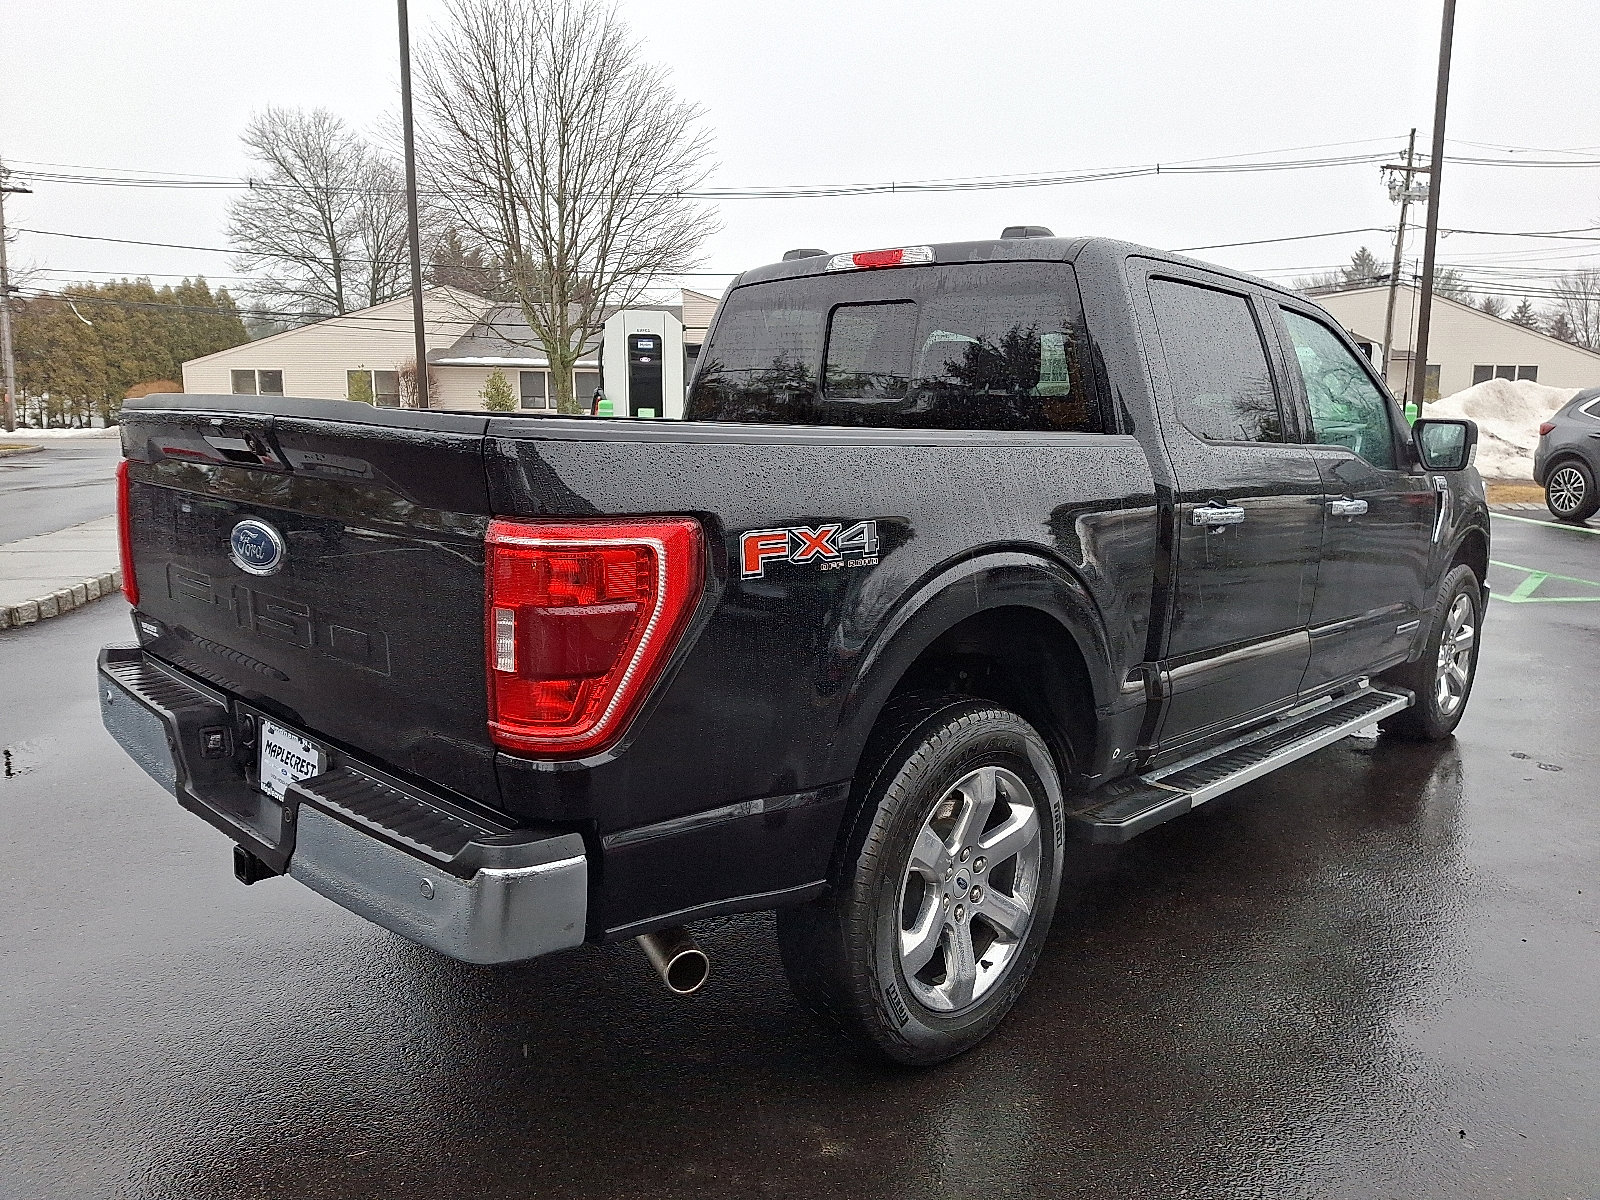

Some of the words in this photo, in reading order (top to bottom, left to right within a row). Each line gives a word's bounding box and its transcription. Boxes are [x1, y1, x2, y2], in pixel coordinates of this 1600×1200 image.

[238, 529, 265, 560] Ford
[739, 520, 880, 580] FX4
[820, 562, 845, 571] OFF
[847, 557, 879, 568] ROAD
[265, 740, 317, 778] MAPLECREST
